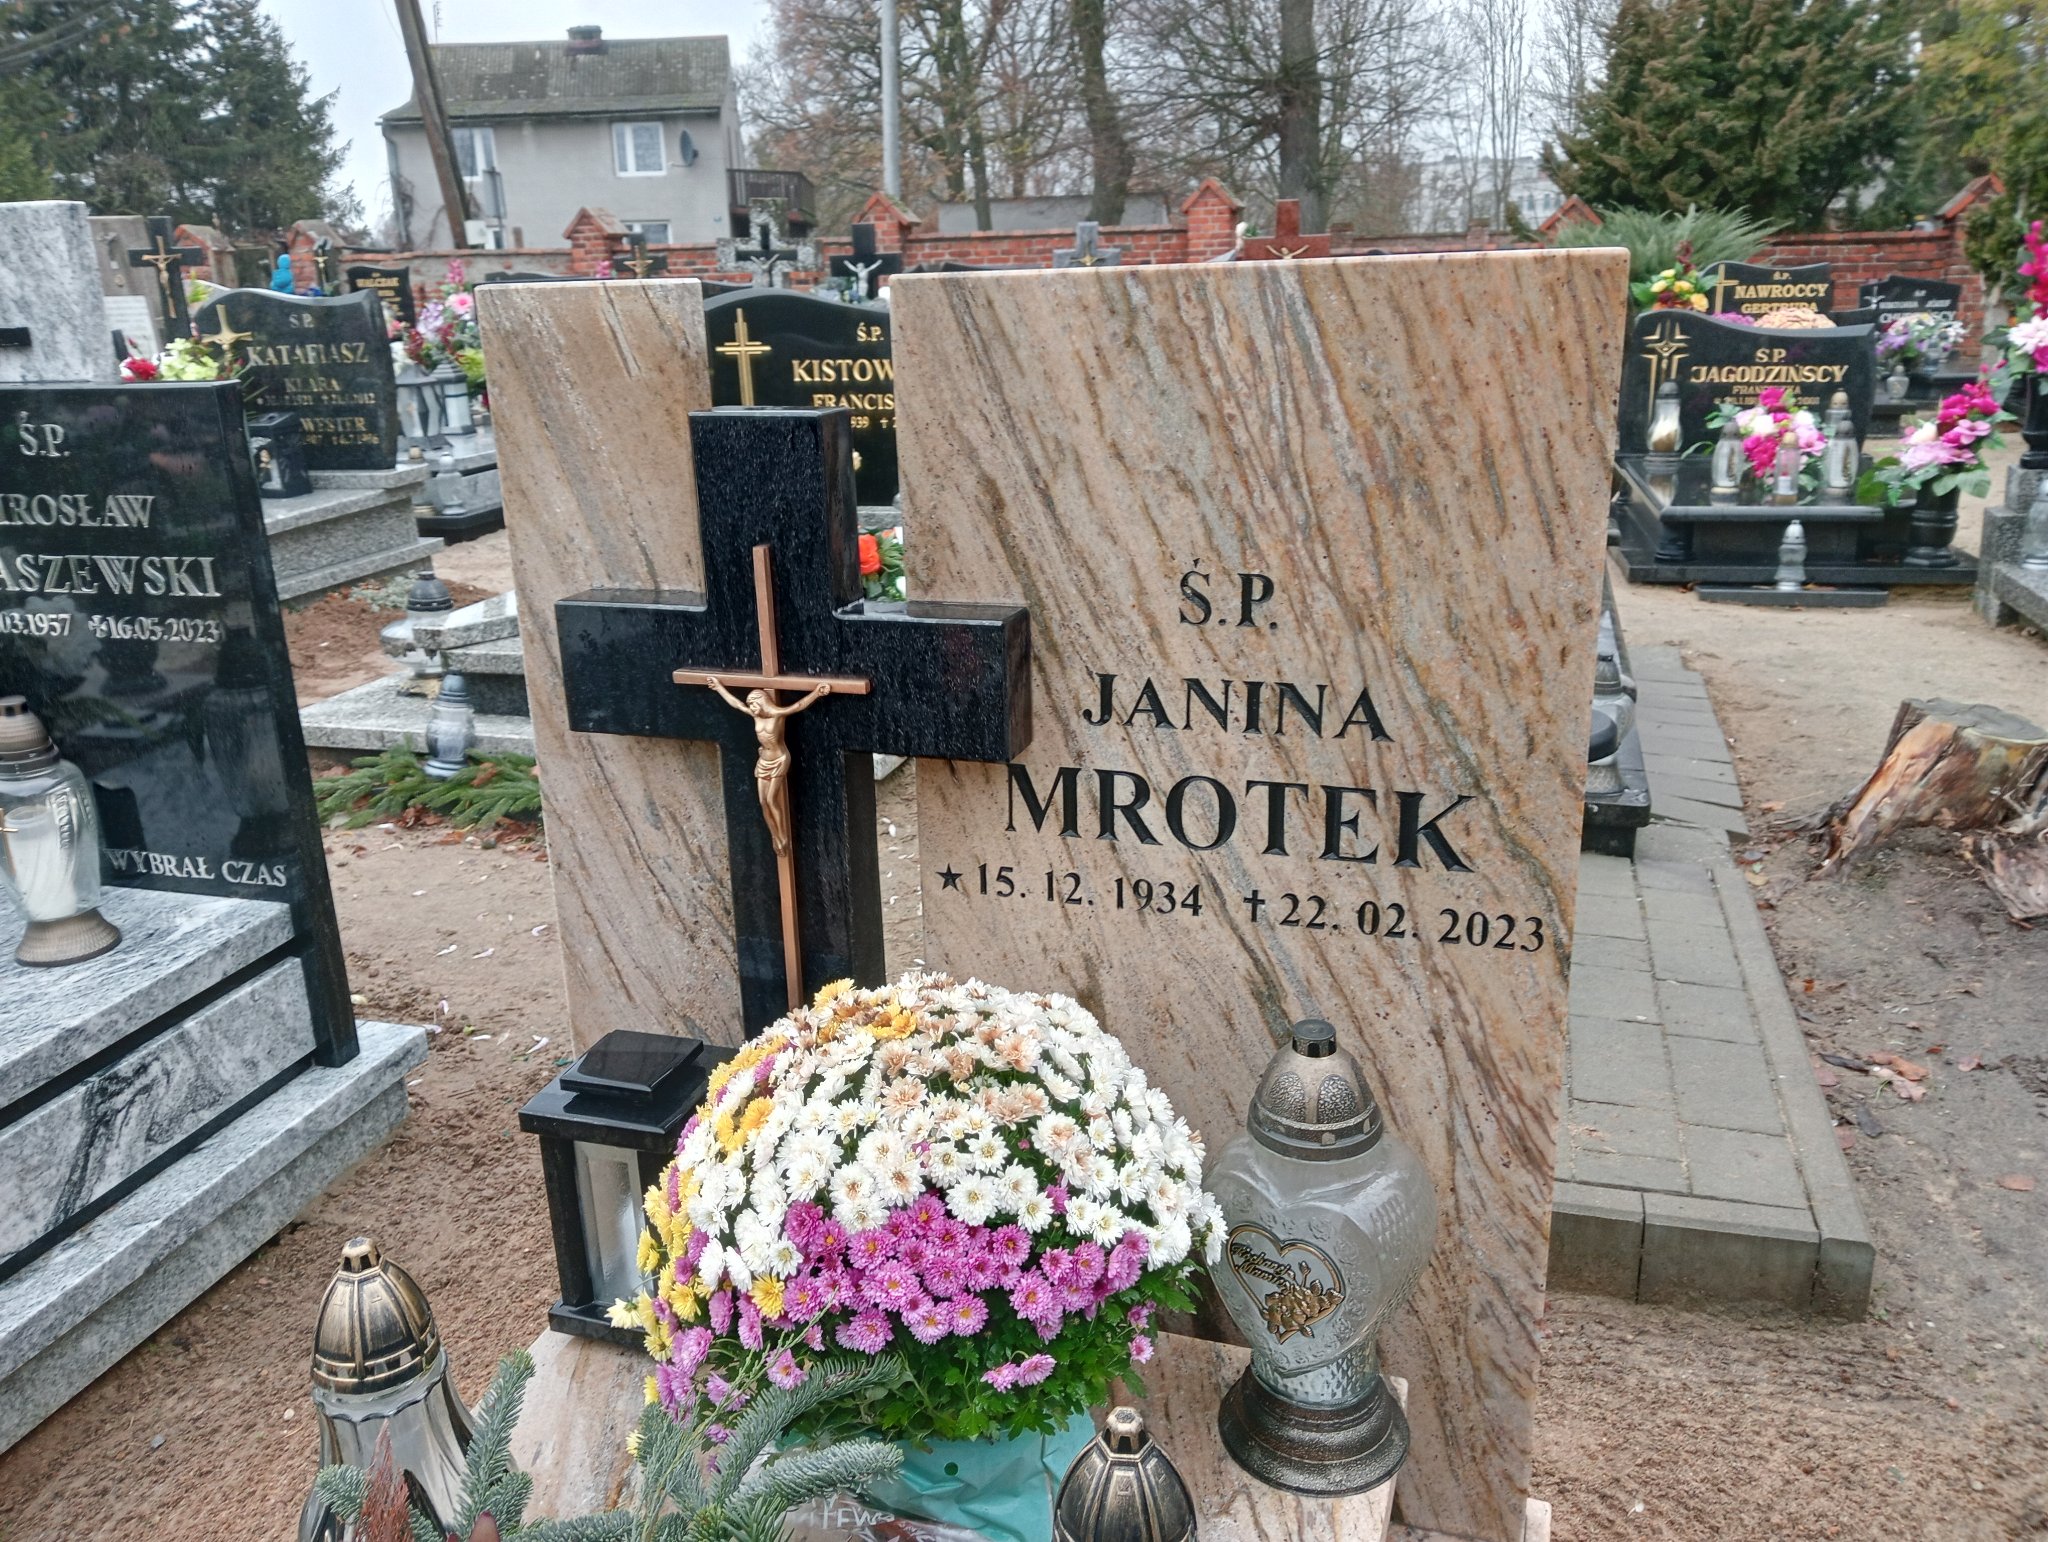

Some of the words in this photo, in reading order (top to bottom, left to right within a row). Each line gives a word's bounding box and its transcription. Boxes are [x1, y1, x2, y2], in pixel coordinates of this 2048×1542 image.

[1734, 283, 1829, 299] NAWROCCY
[856, 322, 884, 342] Ś.P.
[19, 411, 70, 457] Ś.P.
[1179, 558, 1279, 630] Ś.P.
[1082, 672, 1394, 743] JANINA
[1005, 762, 1477, 873] MROTEK
[104, 849, 215, 880] WYBRAŁ
[221, 860, 287, 888] CZAS
[1114, 877, 1203, 917] 1934
[1438, 908, 1544, 952] 2023
